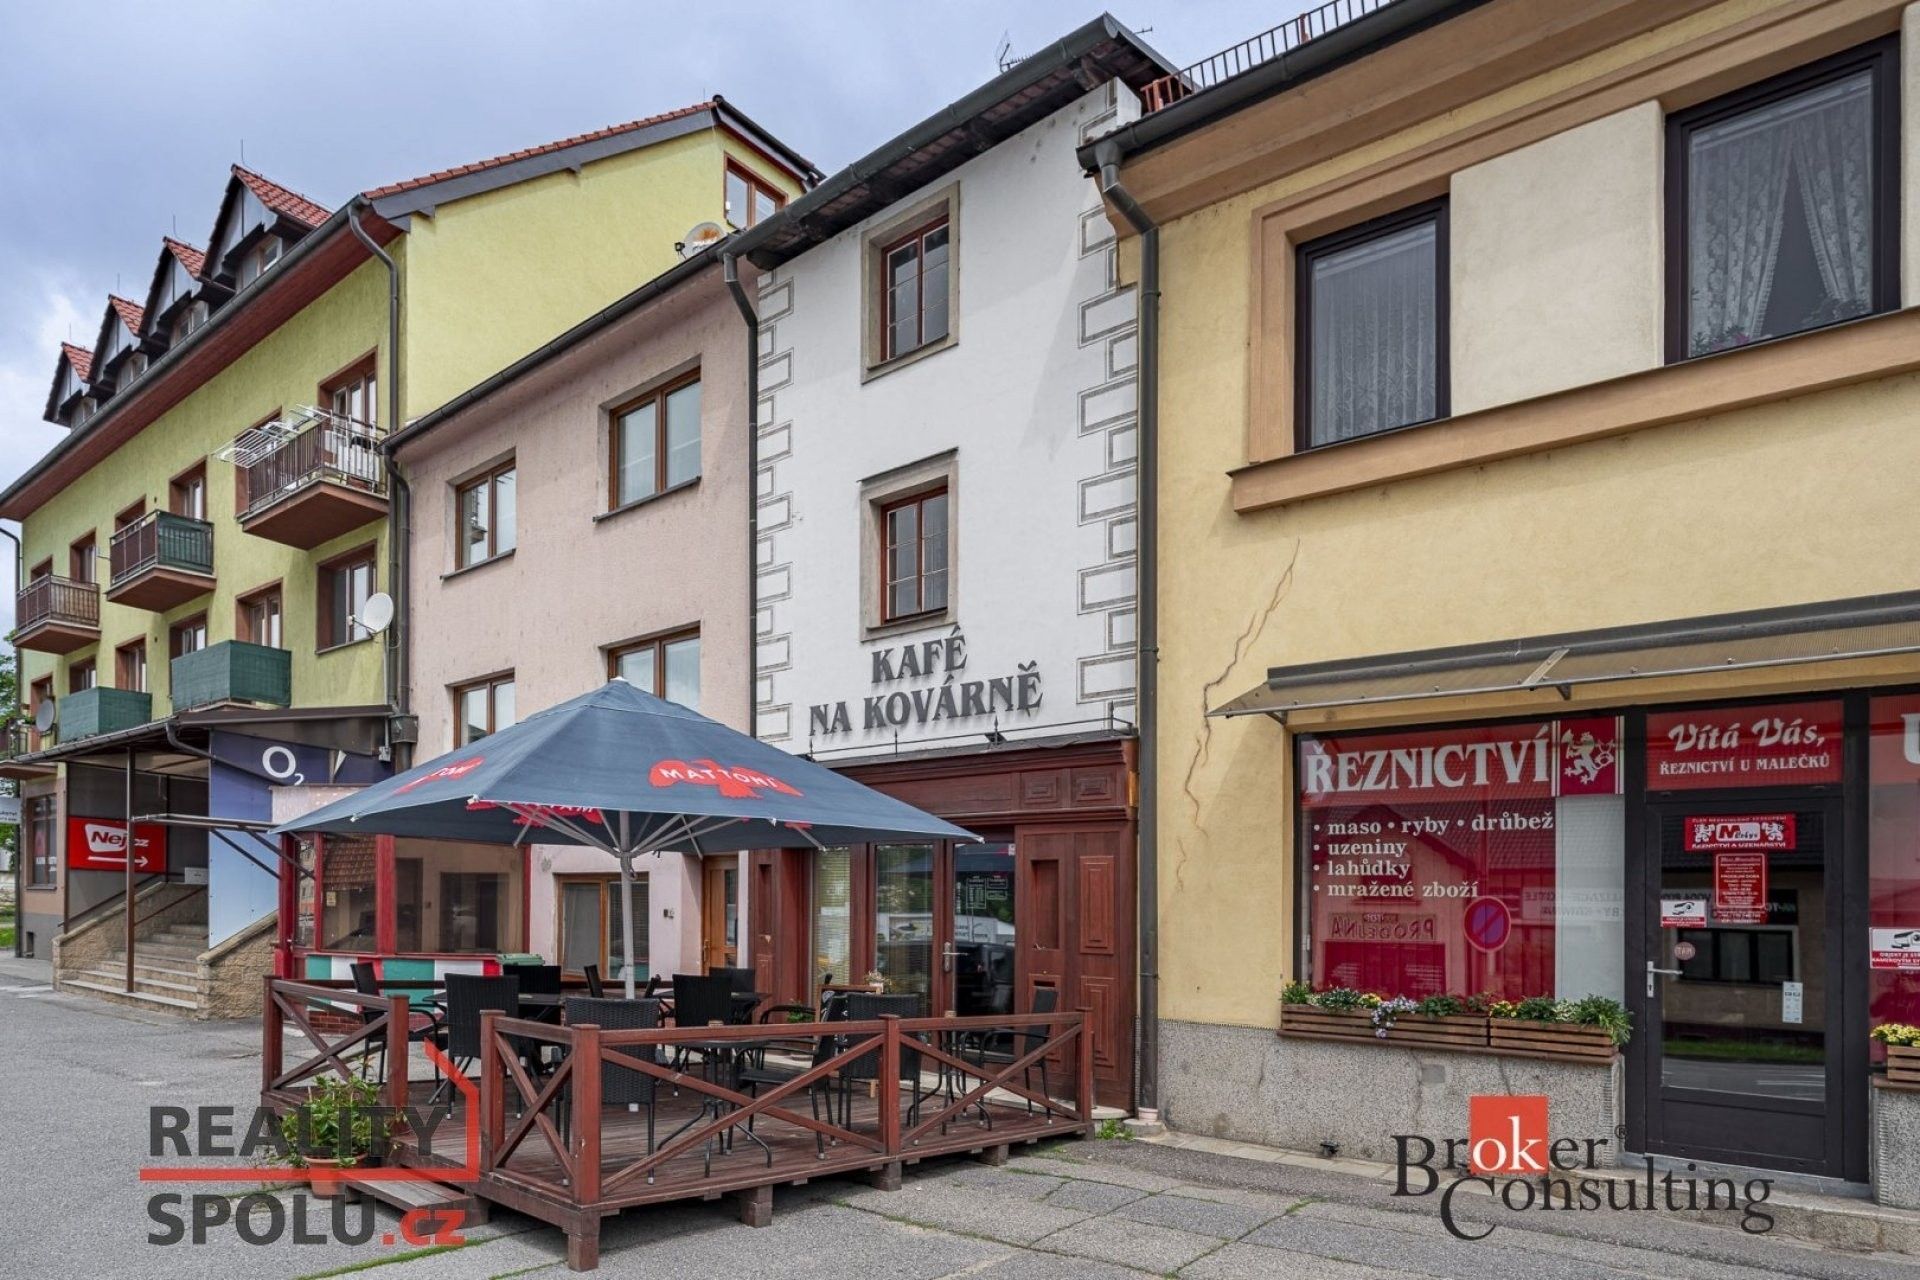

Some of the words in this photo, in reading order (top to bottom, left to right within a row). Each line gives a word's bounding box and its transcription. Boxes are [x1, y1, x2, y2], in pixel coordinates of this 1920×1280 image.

[871, 625, 968, 683] KAFÉ
[808, 701, 852, 736] NA
[863, 660, 1043, 730] KOVÁRNĚ
[1668, 722, 1741, 752] Vítá
[1752, 717, 1825, 748] Vás,
[1306, 724, 1550, 794] ŘEZNICTVÍ
[1659, 757, 1736, 776] ŘEZNICTVÍ
[1740, 759, 1750, 772] U
[1756, 753, 1830, 770] MALEČKŮ
[659, 768, 778, 788] MATTONI
[1327, 821, 1382, 835] maso
[1401, 816, 1450, 837] ryby
[1471, 811, 1554, 831] drůbež
[91, 831, 149, 847] Nejcz
[1327, 838, 1408, 857] uzeniny
[1327, 858, 1411, 879] lahůdky
[1327, 881, 1414, 898] mražené
[1422, 880, 1479, 898] zboží
